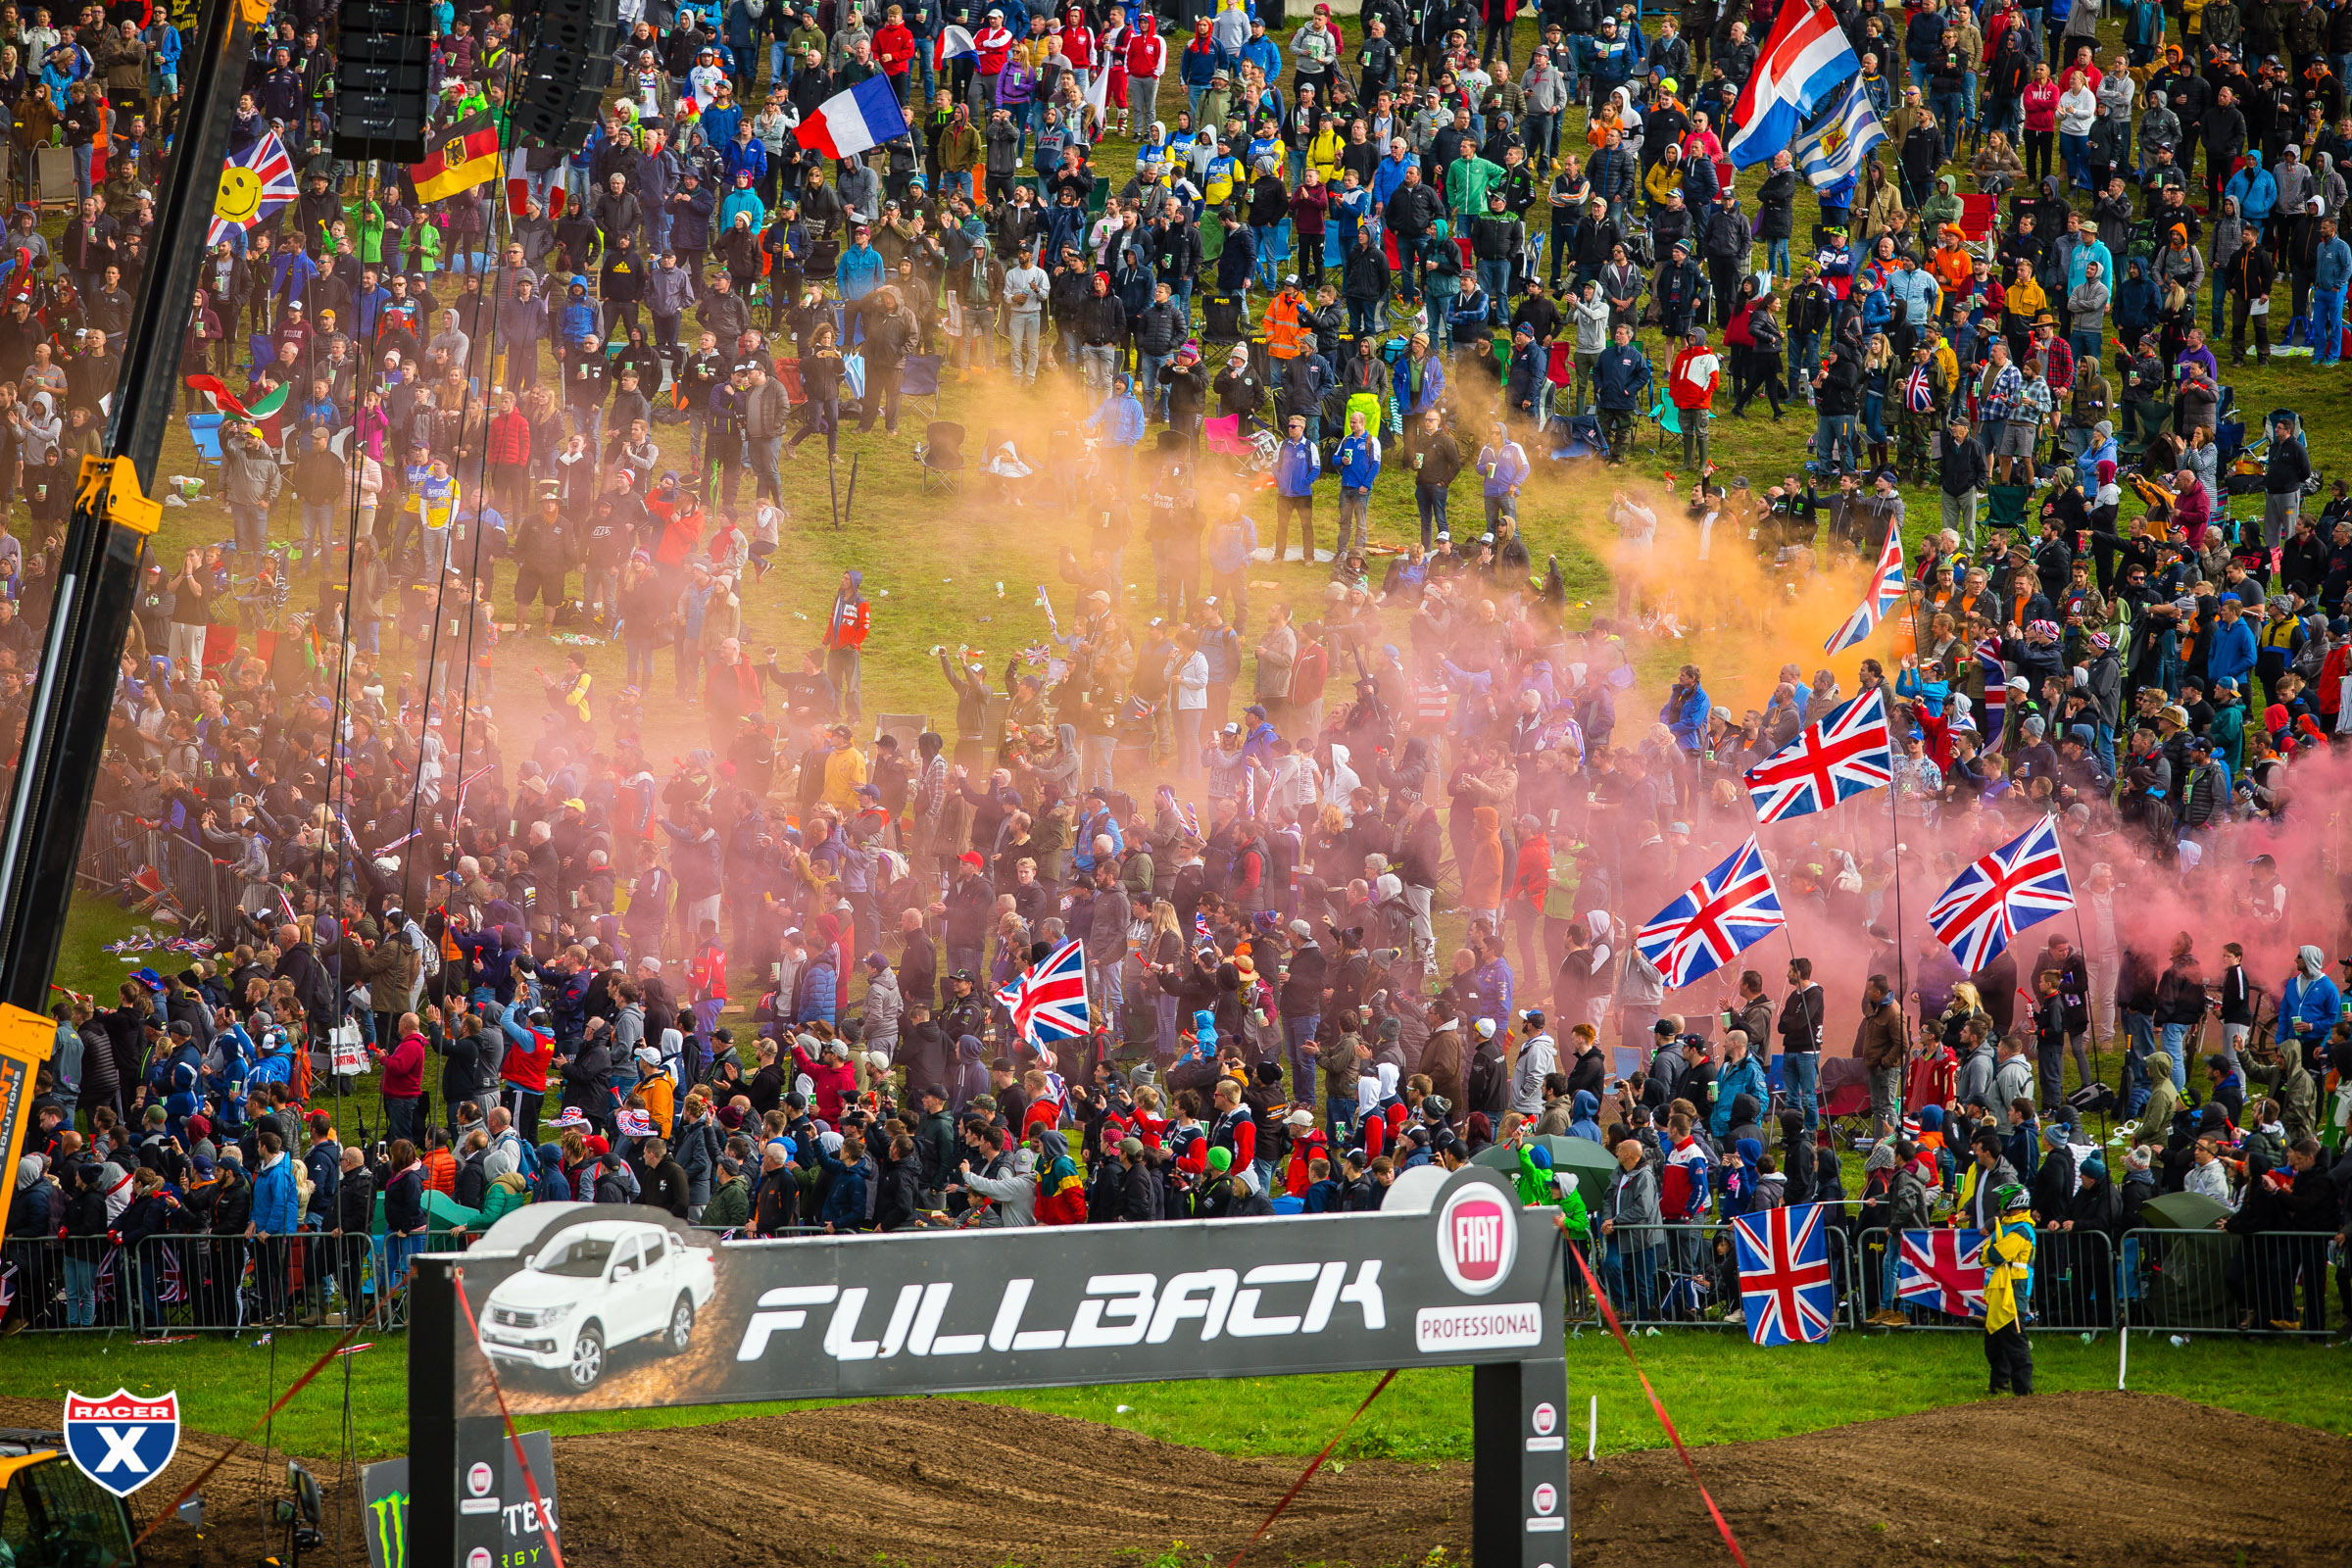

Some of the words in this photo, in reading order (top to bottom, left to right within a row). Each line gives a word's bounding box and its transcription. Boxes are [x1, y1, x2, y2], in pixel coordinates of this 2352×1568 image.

[1, 1070, 22, 1156] SOLUTIONS
[1456, 1215, 1499, 1264] FIAT
[736, 1260, 1387, 1361] FULLBACK
[1421, 1312, 1538, 1340] PROFESSIONAL
[502, 1497, 559, 1536] TER
[502, 1546, 540, 1568] RGY
